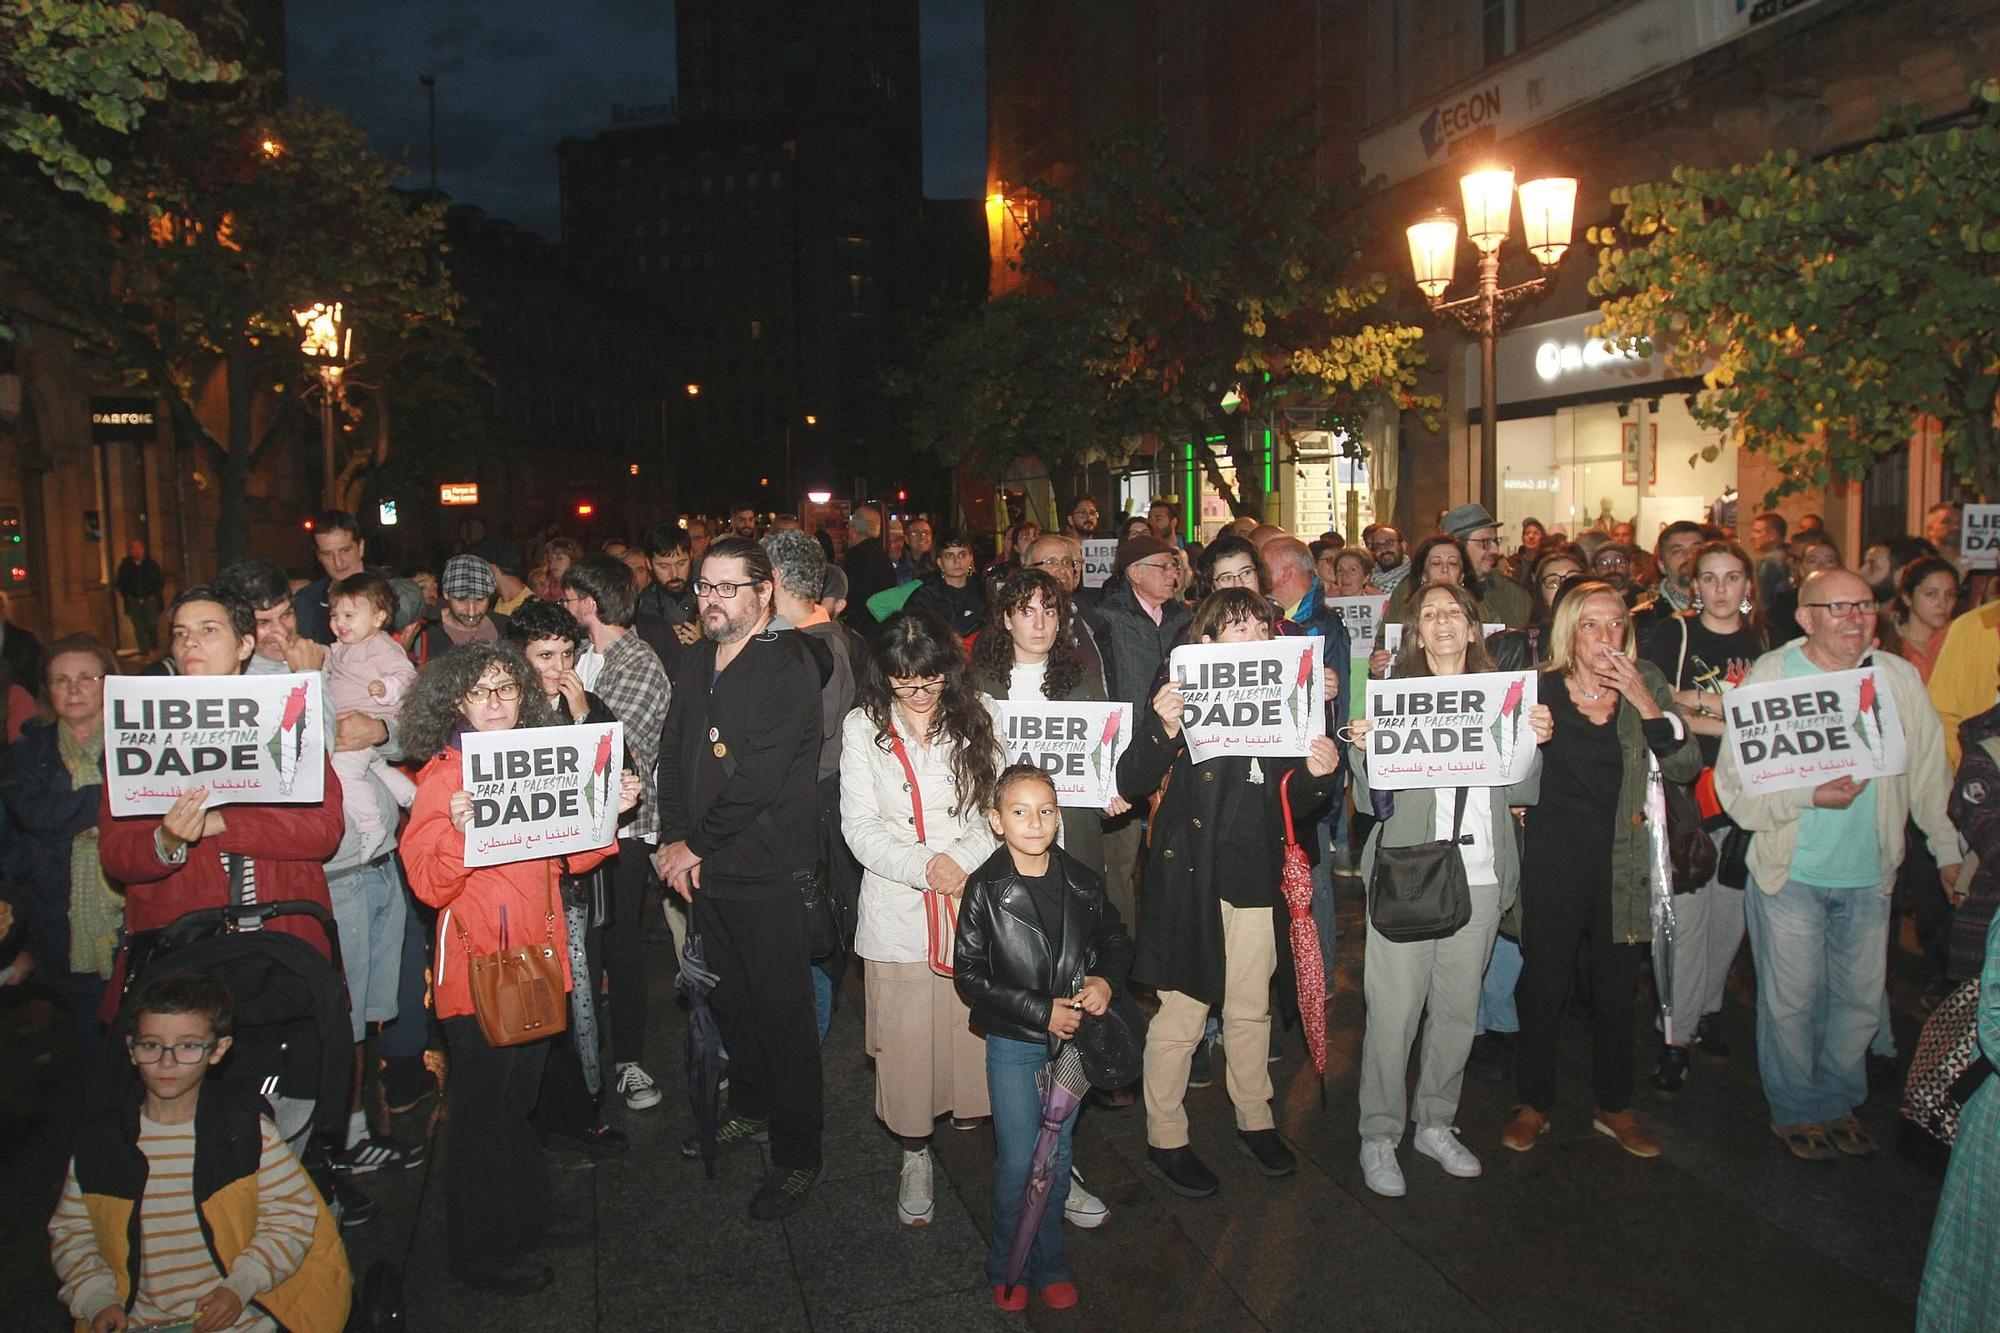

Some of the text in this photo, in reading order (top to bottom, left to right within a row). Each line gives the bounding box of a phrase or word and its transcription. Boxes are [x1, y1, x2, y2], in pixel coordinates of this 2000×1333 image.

[1085, 546, 1117, 557] LIBE
[1966, 536, 2000, 550] DA
[1085, 563, 1114, 574] DA
[1333, 605, 1372, 619] BER
[1349, 626, 1373, 640] DE
[1177, 659, 1283, 691] LIBER
[1183, 686, 1282, 703] PARA A PALESTINA
[1373, 690, 1486, 717] LIBER
[113, 698, 260, 730] LIBER
[1183, 699, 1282, 729] DADE
[1377, 714, 1484, 728] PARA A PALESTINA
[1732, 690, 1844, 729] LIBER
[120, 728, 259, 746] PARA A PALESTINA
[1005, 716, 1088, 740] IBER
[1741, 715, 1844, 740] PARA A PALESTINA
[1021, 740, 1028, 750] A
[1033, 740, 1086, 751] PALESTINA
[1374, 727, 1484, 755] DADE
[1740, 727, 1850, 765] DADE
[116, 744, 259, 776] DADE
[471, 745, 579, 783] LIBER
[1015, 752, 1085, 776] ADE
[477, 775, 578, 798] PARA A PALESTINA
[473, 788, 579, 829] DADE
[477, 832, 523, 855] فلسطين
